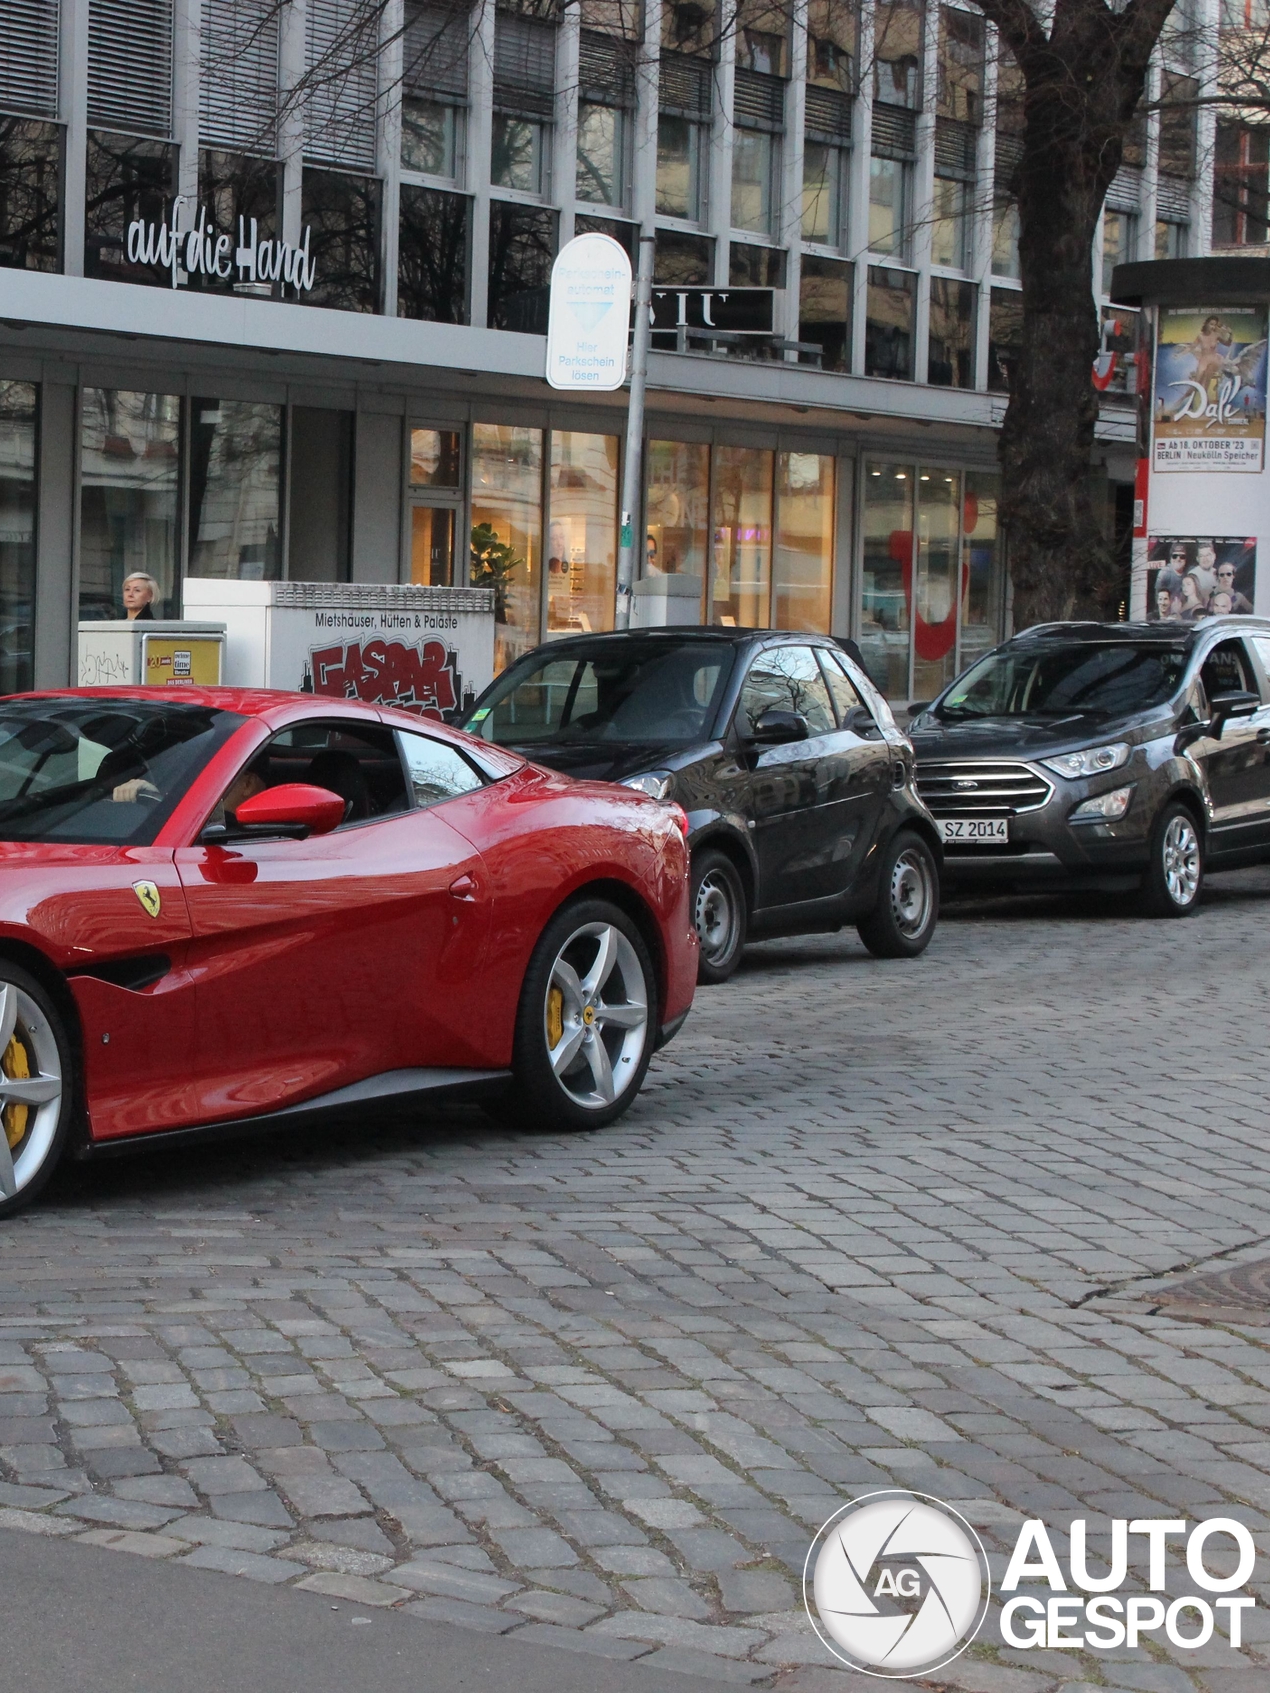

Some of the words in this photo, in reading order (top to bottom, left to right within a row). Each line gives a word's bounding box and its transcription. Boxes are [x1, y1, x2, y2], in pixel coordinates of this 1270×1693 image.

[128, 195, 187, 289] auf
[187, 206, 232, 278] die
[236, 214, 316, 291] Hand
[567, 284, 615, 295] automat
[577, 342, 598, 353] Hier
[559, 355, 615, 367] Parkschein
[572, 369, 599, 381] lösen
[1168, 441, 1178, 450] Ab
[1192, 441, 1231, 450] OKTOBER
[1157, 451, 1182, 460] BERLIN
[1187, 451, 1223, 460] Neukölln
[1224, 452, 1259, 462] Speicher
[315, 612, 377, 630] Mietshäuser,
[381, 614, 412, 629] Hütten
[414, 615, 421, 628] &
[424, 615, 458, 630] Paläste
[174, 660, 190, 669] time
[945, 822, 965, 837] SZ
[968, 821, 1005, 837] 2014
